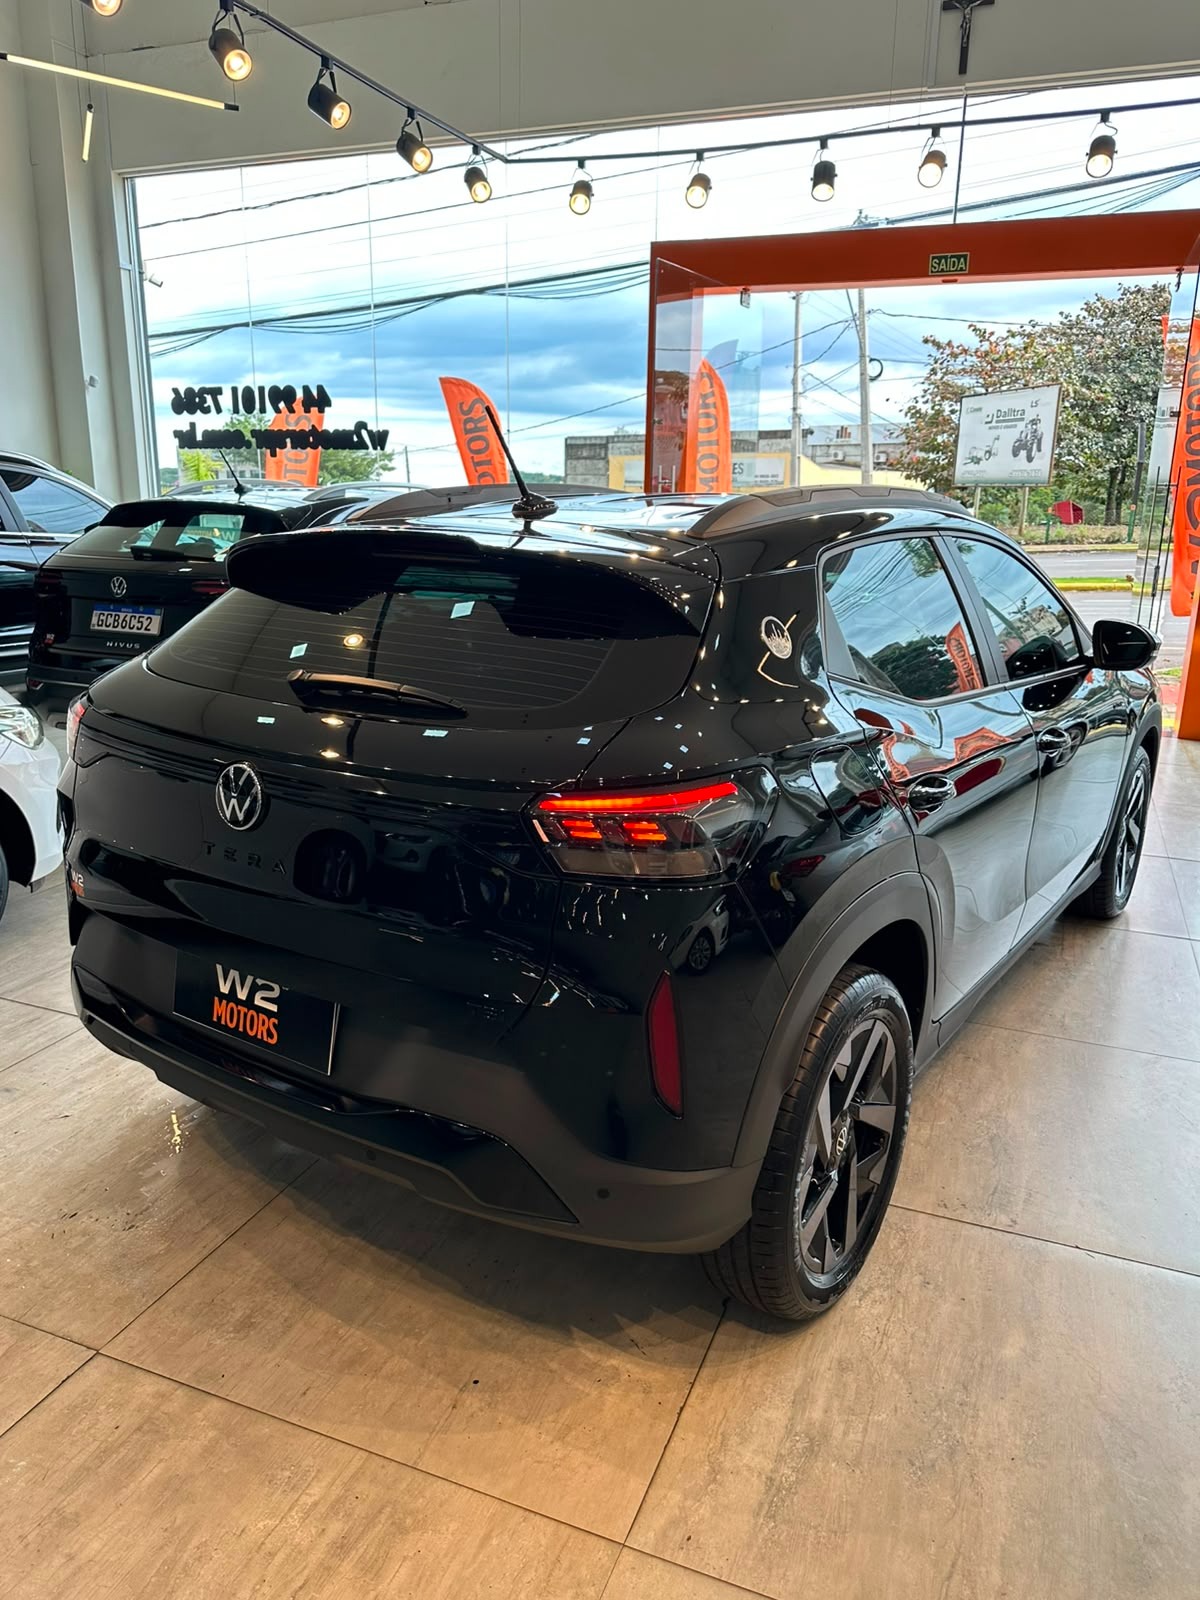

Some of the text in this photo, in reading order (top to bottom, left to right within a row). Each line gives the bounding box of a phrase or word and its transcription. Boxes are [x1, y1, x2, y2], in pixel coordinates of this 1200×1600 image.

[931, 254, 966, 272] SAÍDA
[996, 408, 1026, 419] Dalltra
[458, 397, 495, 485] OTORS
[96, 612, 153, 632] GCB6C52
[106, 641, 141, 649] NIVUS
[202, 840, 287, 876] TERA
[216, 963, 280, 1013] W2
[213, 996, 278, 1045] MOTORS
